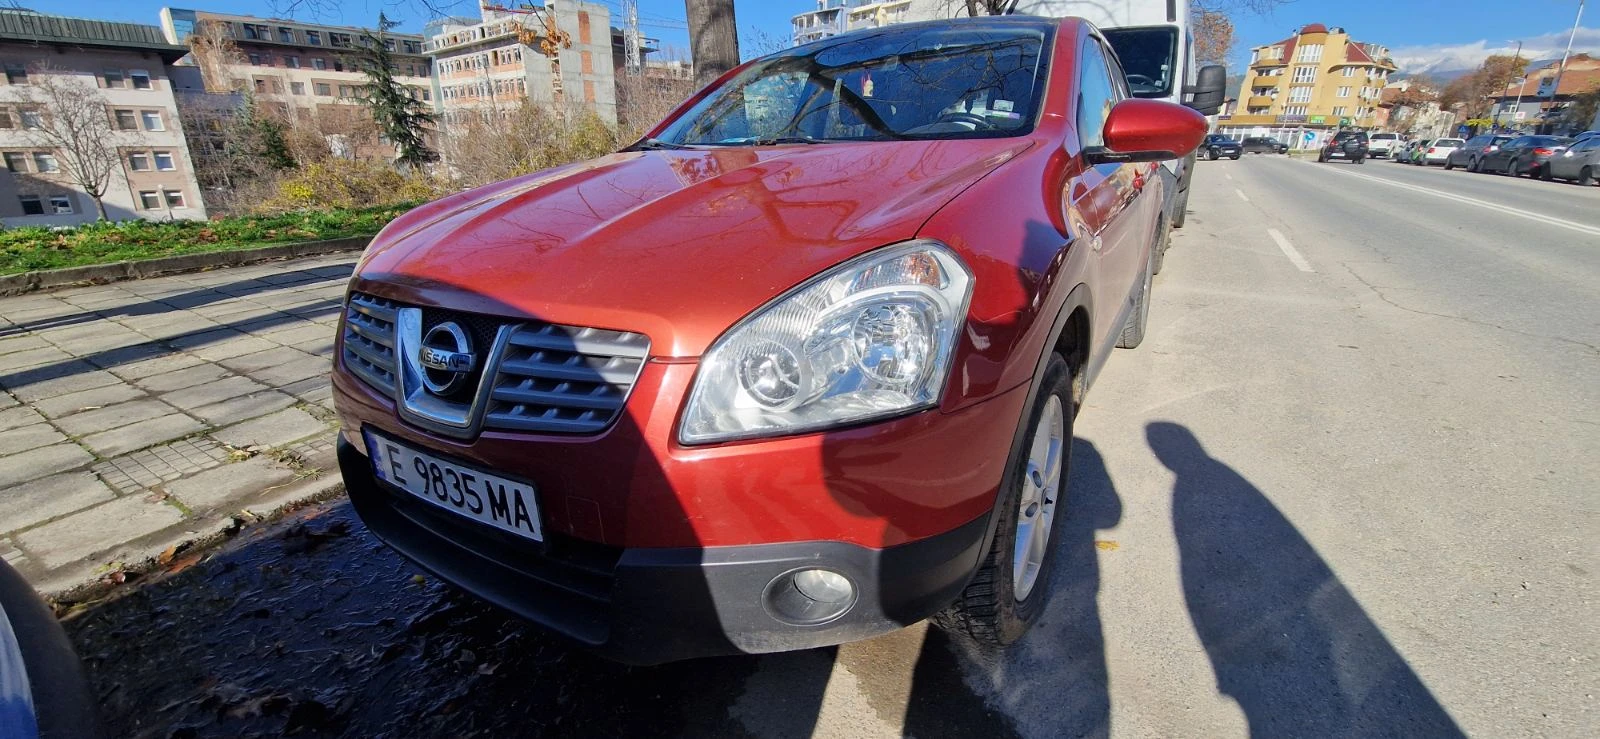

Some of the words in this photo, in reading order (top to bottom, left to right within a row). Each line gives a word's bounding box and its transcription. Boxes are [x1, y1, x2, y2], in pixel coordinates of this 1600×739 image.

[420, 349, 459, 368] NISSAN
[386, 444, 407, 485] E
[413, 456, 484, 515] 9835
[485, 480, 535, 533] MA
